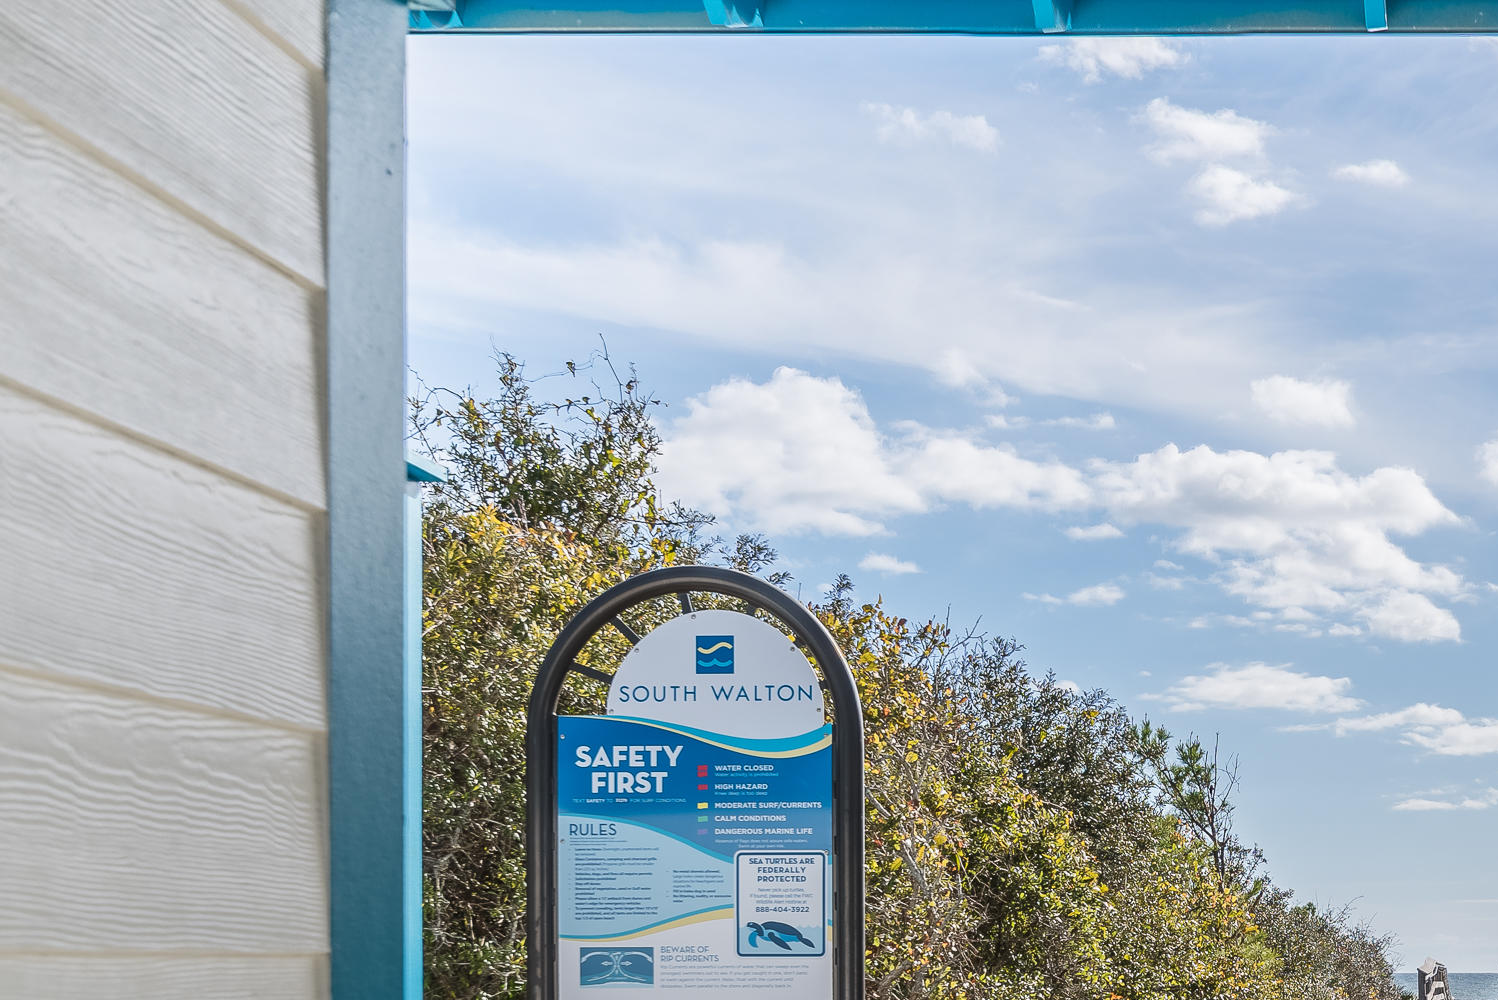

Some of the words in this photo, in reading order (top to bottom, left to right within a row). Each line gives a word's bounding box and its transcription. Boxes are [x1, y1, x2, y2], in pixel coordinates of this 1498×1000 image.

[619, 685, 697, 703] SOUTH
[711, 684, 813, 702] WALTON
[575, 745, 683, 767] SAFETY
[591, 771, 668, 794] FIRST
[758, 801, 822, 809] SURF/CURRENTS
[569, 823, 617, 836] RULES
[675, 954, 719, 962] CURRENTS
